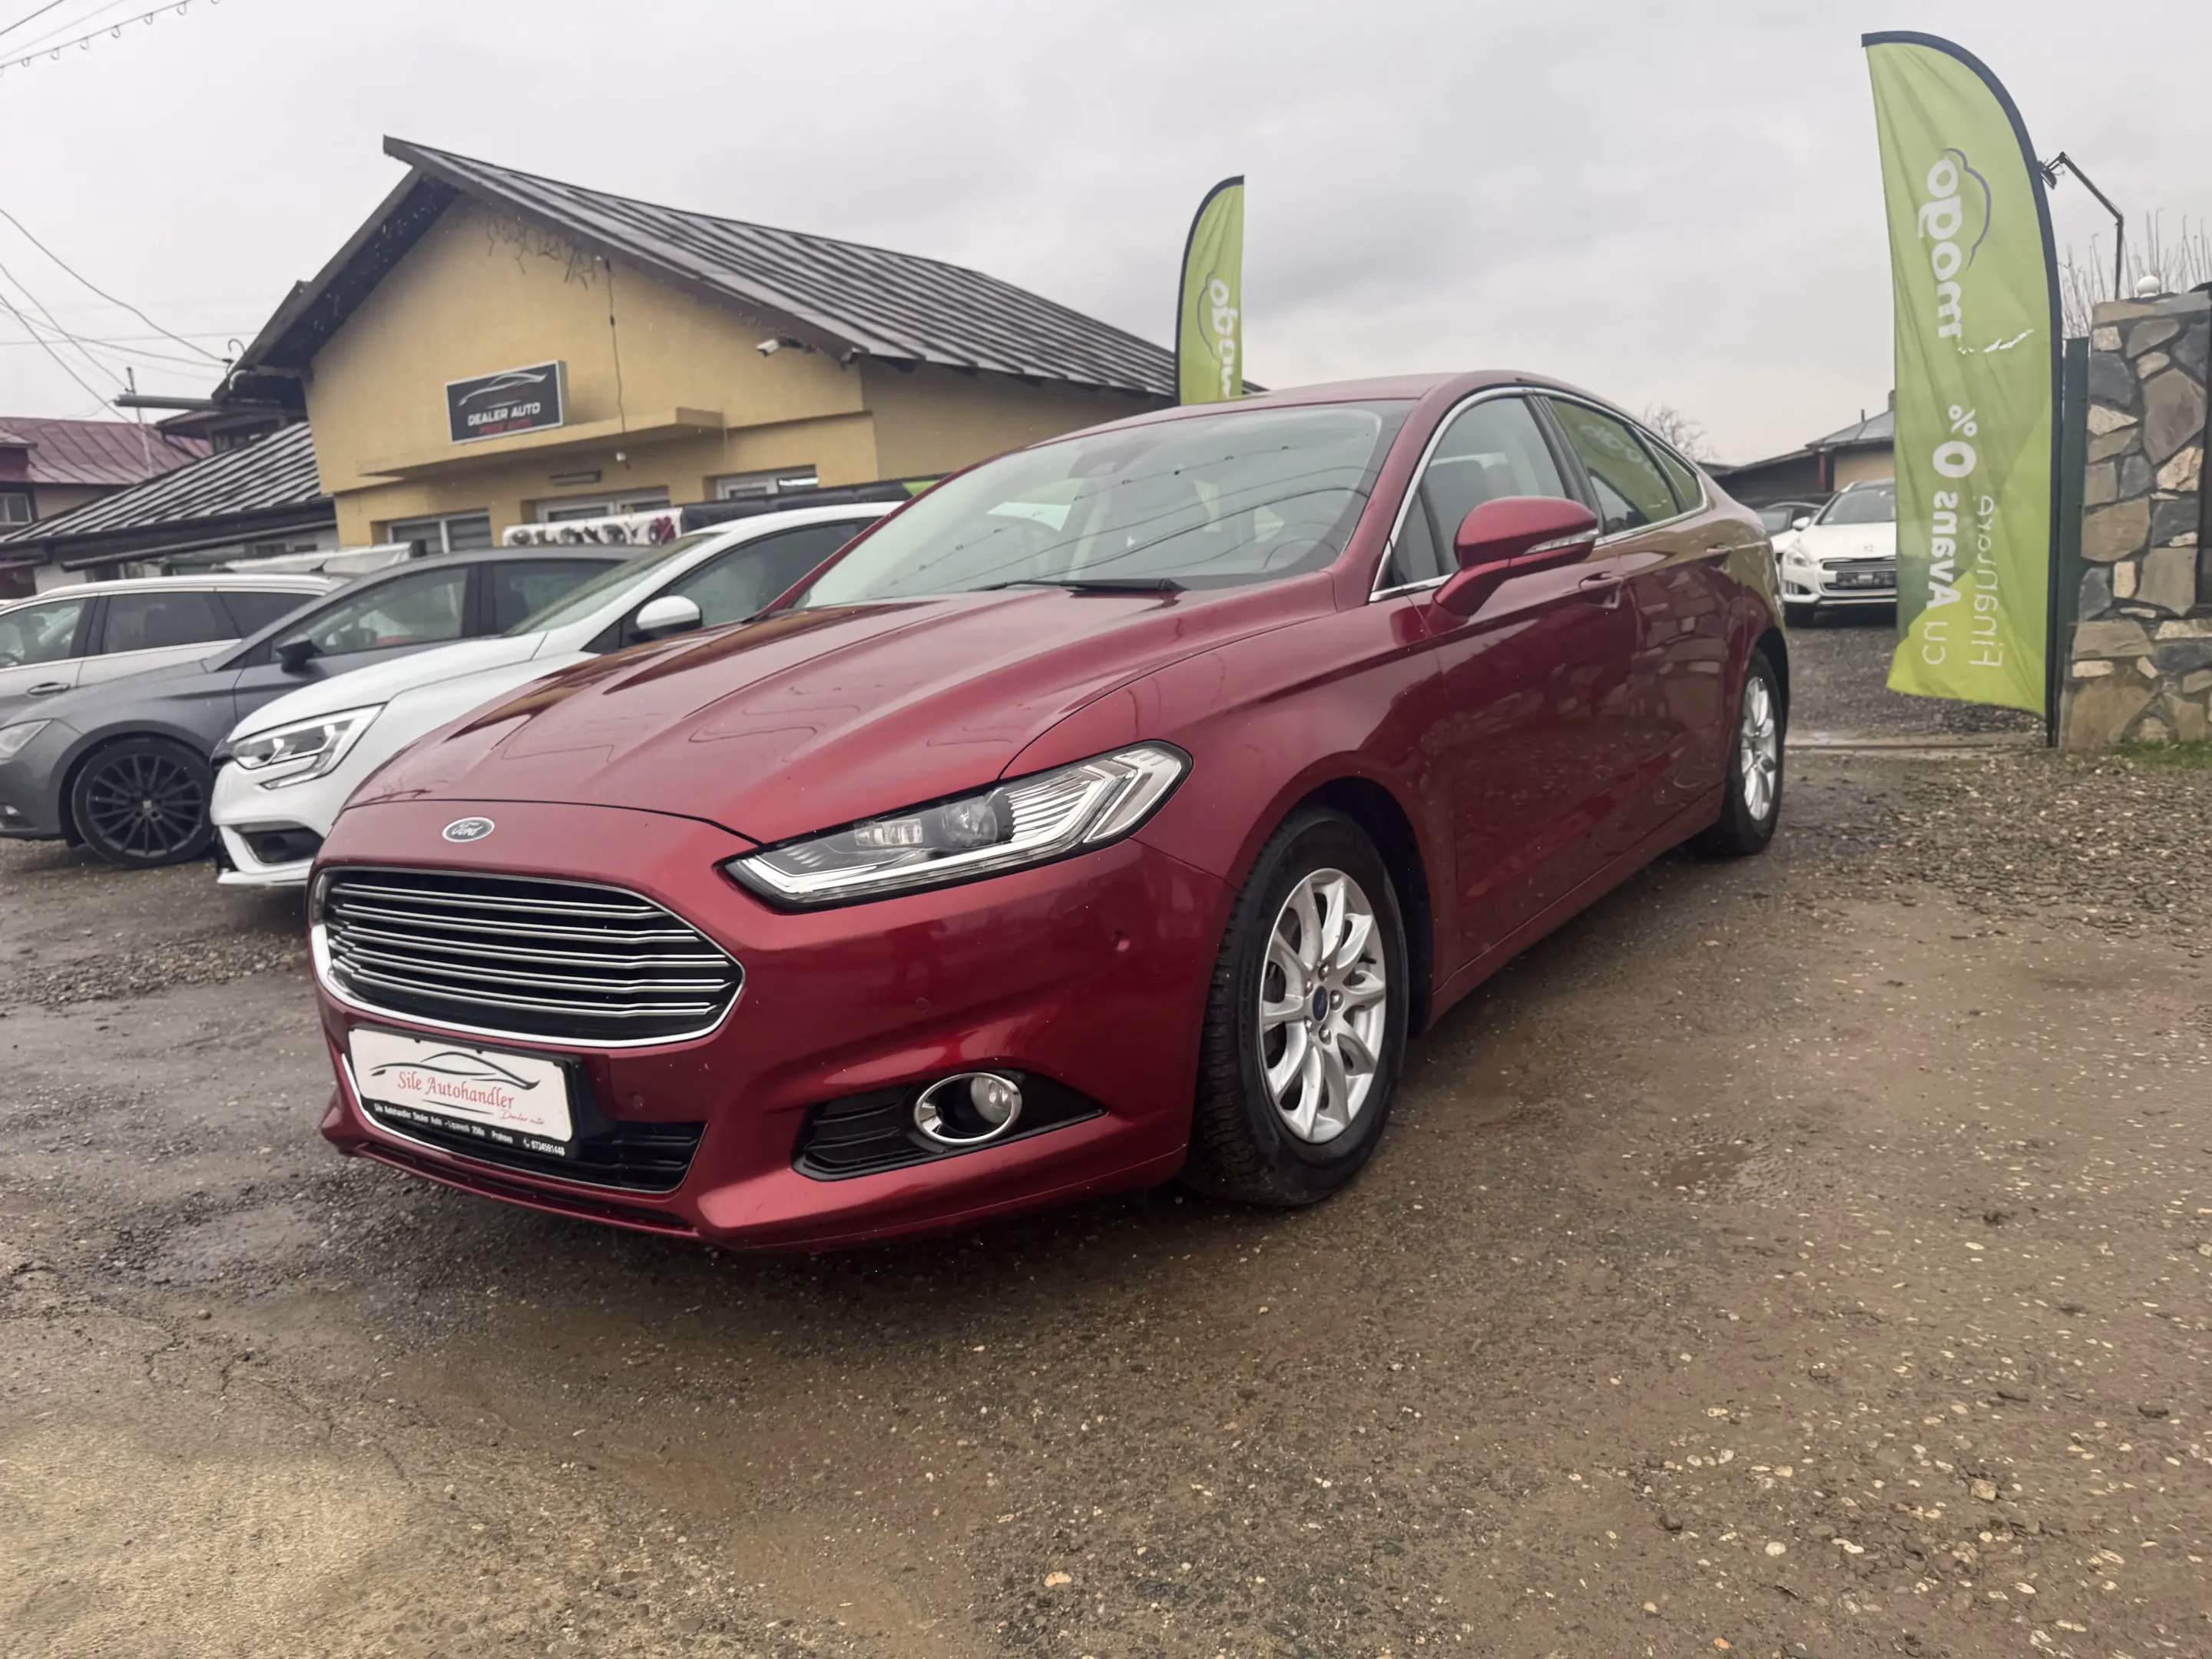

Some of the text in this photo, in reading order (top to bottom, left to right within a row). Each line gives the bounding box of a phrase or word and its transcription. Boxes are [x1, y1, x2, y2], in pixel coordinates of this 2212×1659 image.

[467, 402, 541, 426] DEALER AUTO
[398, 1071, 515, 1108] Sile Autohandler
